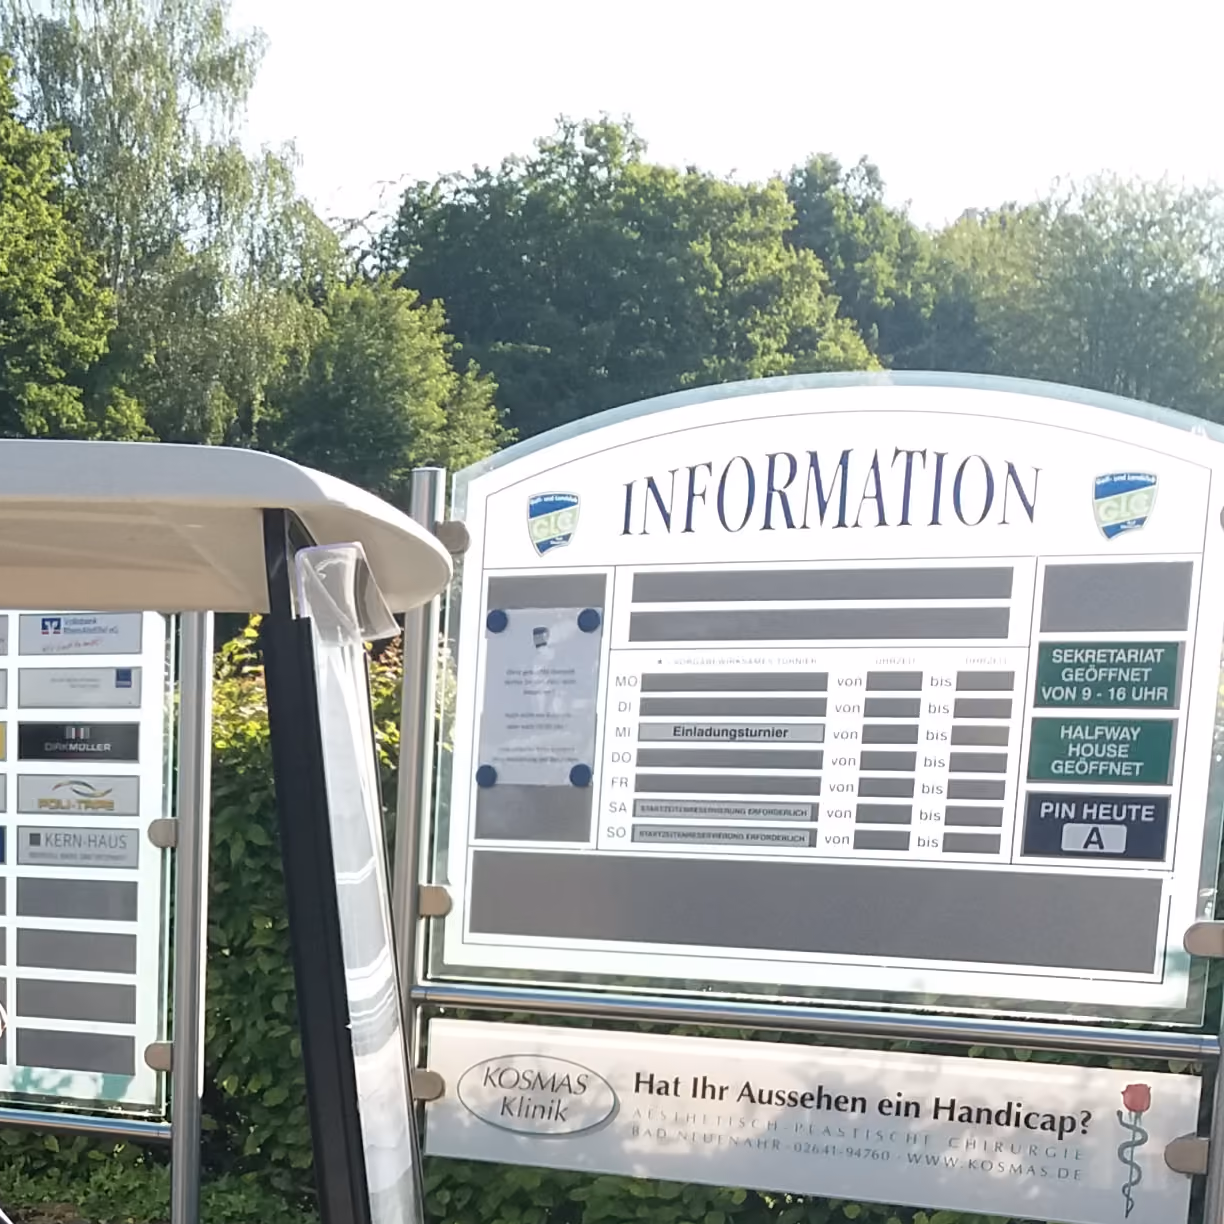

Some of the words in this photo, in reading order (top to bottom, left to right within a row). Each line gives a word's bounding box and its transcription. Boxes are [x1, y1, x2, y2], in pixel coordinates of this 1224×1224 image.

[620, 446, 1043, 536] INFORMATION
[1052, 649, 1164, 663] SEKRETARIAT
[615, 676, 638, 688] MO
[837, 676, 862, 687] von
[930, 676, 952, 687] bis
[1061, 665, 1152, 682] GEÖFFNET
[1042, 687, 1076, 700] VON
[1082, 687, 1092, 700] 9
[1108, 687, 1126, 700] 16
[1131, 687, 1168, 701] UHR
[617, 702, 632, 713] DI
[835, 703, 860, 713] von
[928, 702, 950, 714] bis
[615, 727, 631, 738] MI
[673, 726, 789, 740] Einladungsturnier
[833, 729, 858, 740] von
[926, 729, 948, 741] bis
[1060, 725, 1141, 741] HALFWAY
[1068, 743, 1130, 758] HOUSE
[611, 752, 632, 763] DO
[831, 756, 856, 767] von
[924, 756, 946, 768] bis
[1051, 758, 1144, 776] GEÖFFNET
[611, 777, 629, 788] FR
[829, 782, 854, 793] von
[921, 783, 943, 794] bis
[608, 802, 627, 813] SA
[827, 809, 852, 819] von
[919, 809, 941, 821] bis
[1040, 802, 1076, 818] PIN
[1082, 803, 1155, 821] HEUTE
[45, 832, 128, 850] KERN-HAUS
[606, 827, 626, 838] SO
[825, 834, 850, 845] von
[917, 836, 939, 848] bis
[1083, 827, 1105, 850] A
[483, 1066, 588, 1095] KOSMAS
[500, 1096, 569, 1122] Klinik
[634, 1072, 680, 1098] Hat
[692, 1076, 729, 1101] Ihr
[736, 1081, 867, 1114] Aussehen
[877, 1092, 920, 1118] ein
[932, 1097, 1092, 1140] Handicap?
[632, 1125, 667, 1139] BAD
[793, 1141, 890, 1161] 02641-94760
[948, 1137, 1083, 1161] CHIRURGIE
